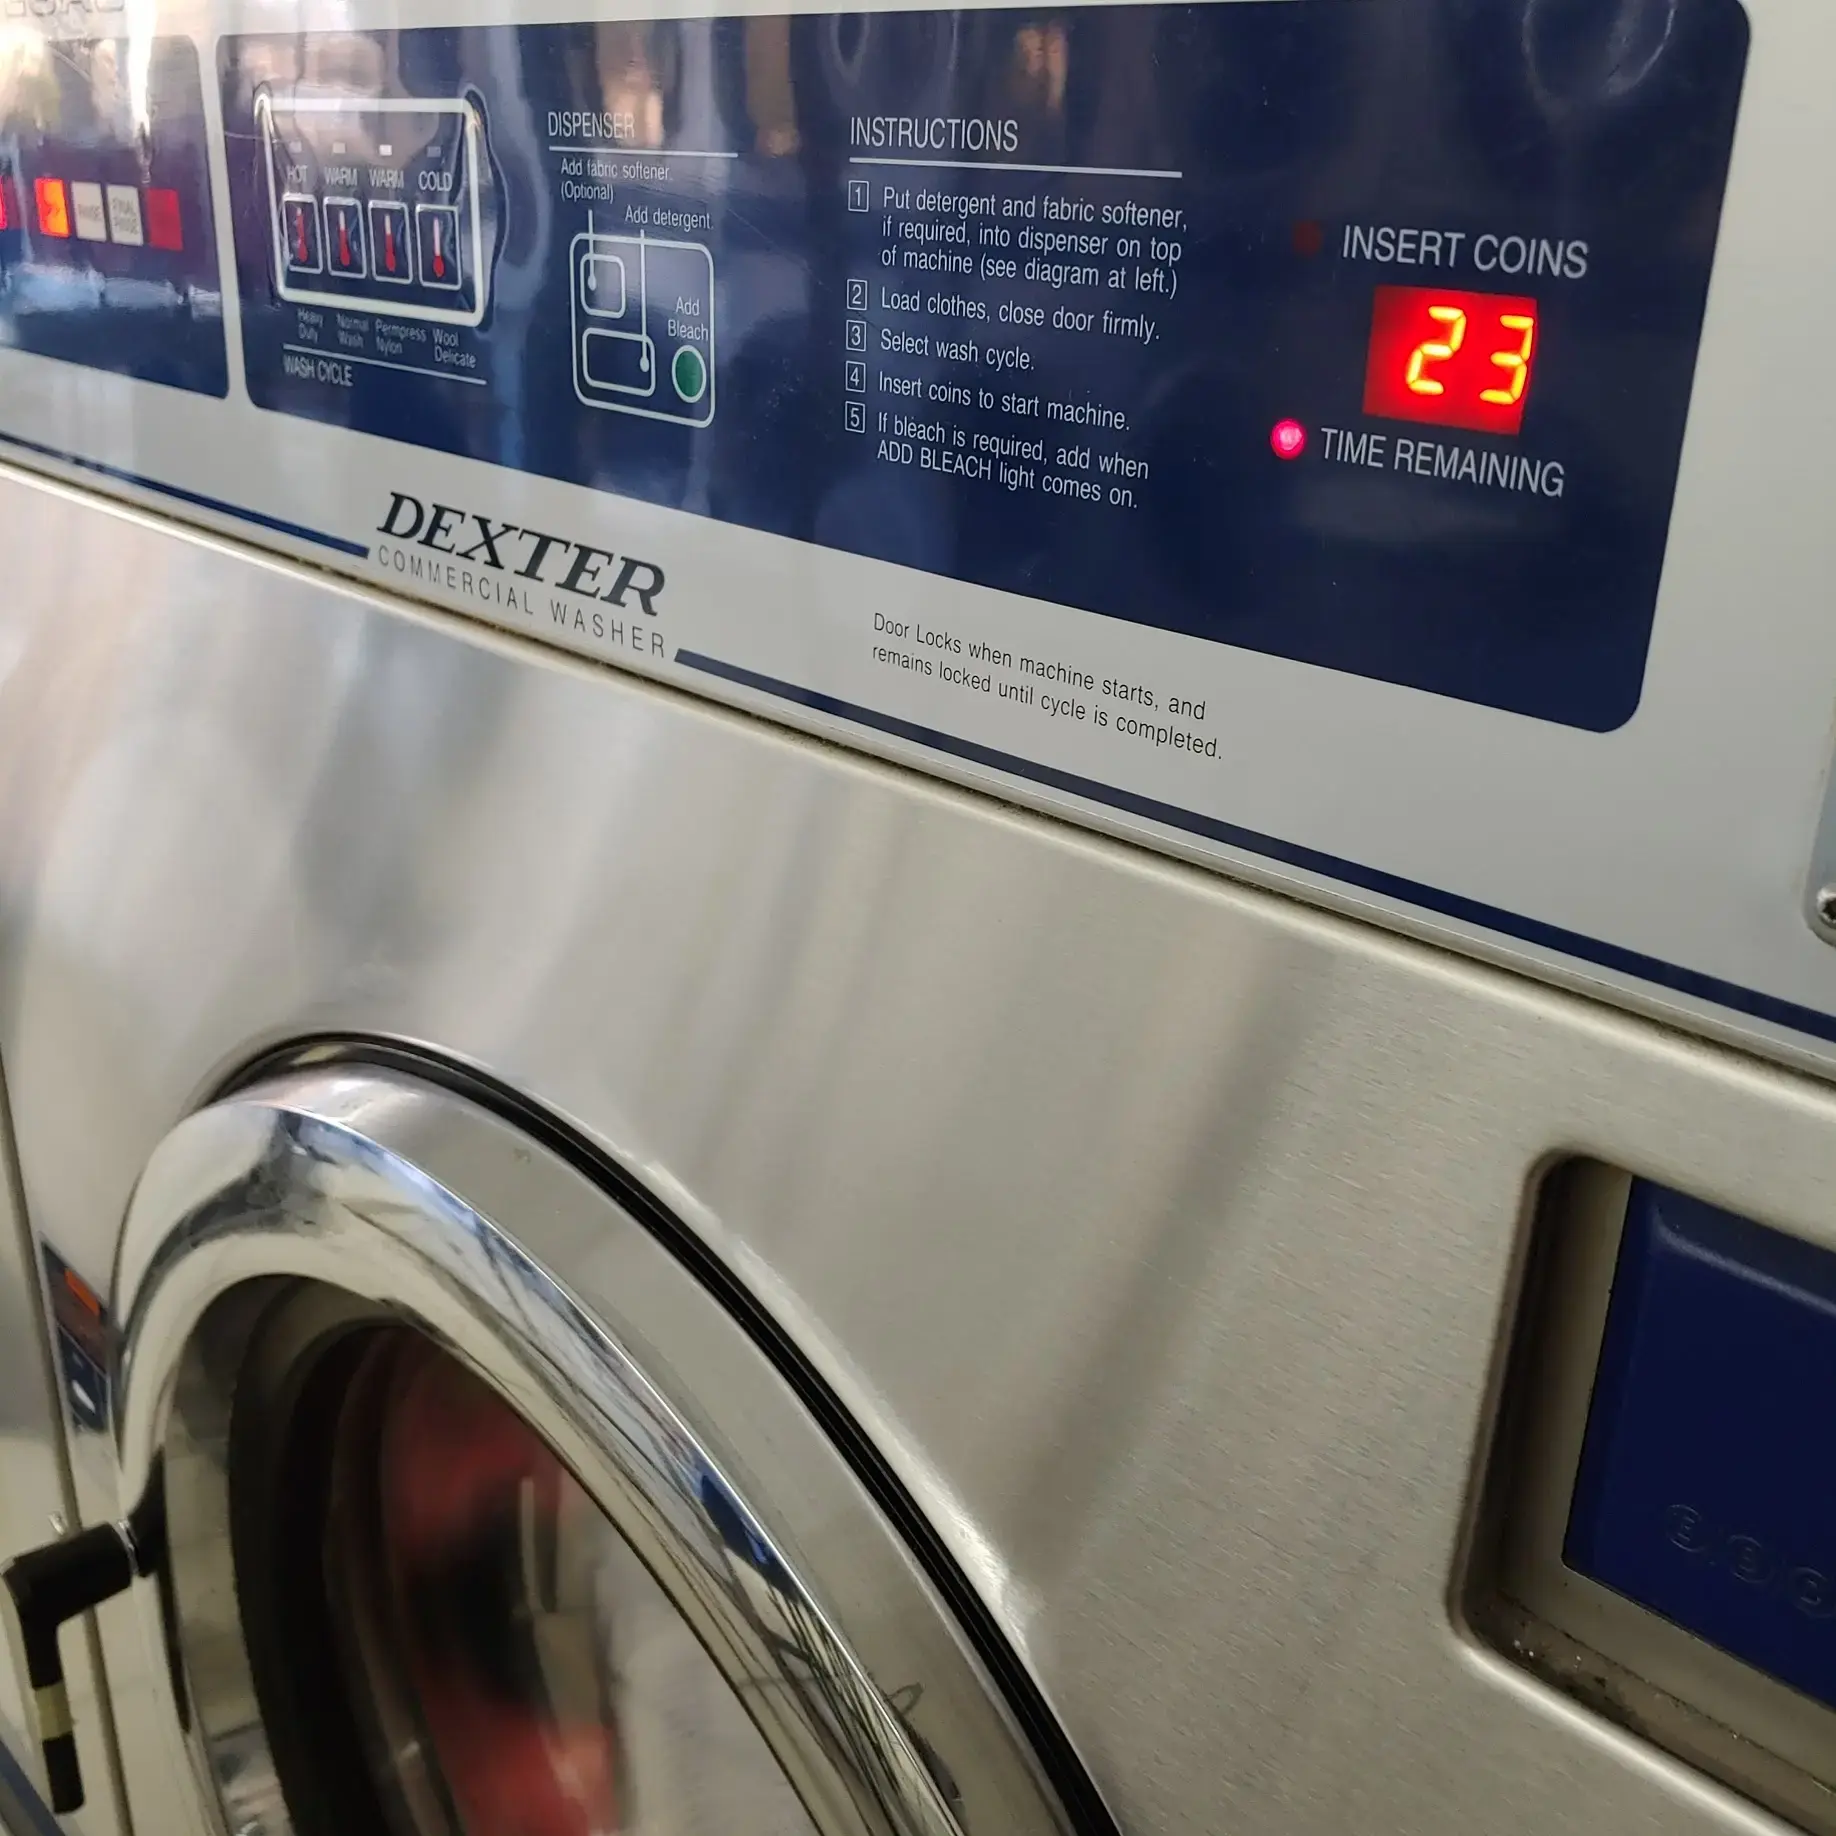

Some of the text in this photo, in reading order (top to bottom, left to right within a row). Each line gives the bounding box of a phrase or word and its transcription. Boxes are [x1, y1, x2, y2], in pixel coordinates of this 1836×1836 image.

[548, 111, 635, 139] DISPENSER
[850, 117, 1019, 151] INSTRUCTIONS
[287, 166, 308, 182] HOT
[324, 168, 358, 186] WARM
[369, 169, 404, 188] WARM
[418, 171, 452, 192] COLD
[561, 158, 673, 181] Add fabric softener.
[561, 180, 613, 203] (Optional)
[883, 186, 910, 210] Put
[916, 189, 996, 218] detergent
[1003, 196, 1035, 218] and
[1043, 196, 1094, 223] fabric
[1102, 200, 1187, 231] softener,
[625, 205, 714, 232] Add detergent.
[882, 215, 1182, 265] if required, into dispenser on top
[1343, 225, 1589, 279] INSERT COINS
[882, 245, 1177, 299] of machine (see diagram at left.)
[676, 297, 700, 316] Add
[882, 287, 920, 312] Load
[927, 292, 990, 323] clothes,
[999, 300, 1044, 327] close
[1053, 306, 1094, 331] door
[1103, 310, 1160, 345] firmly.
[375, 319, 428, 342] Permpress
[376, 336, 403, 356] Nylon
[432, 328, 459, 346] Wool
[668, 320, 709, 341] Bleach
[434, 345, 476, 368] Delicate
[880, 328, 929, 356] Select
[936, 338, 978, 362] wash
[986, 346, 1035, 371] cycle.
[1406, 306, 1534, 405] 23
[283, 355, 354, 387] WASH CYCLE
[879, 371, 922, 398] Insert
[929, 381, 971, 406] coins
[978, 388, 994, 409] to
[1001, 394, 1039, 417] start
[1047, 401, 1130, 431] machine.
[878, 412, 888, 432] If
[894, 415, 945, 443] bleach
[953, 425, 965, 447] is
[973, 432, 1048, 464] required,
[1056, 445, 1090, 469] add
[1099, 452, 1149, 480] when
[1321, 427, 1565, 498] TIME REMAINING
[878, 439, 1138, 508] ADD BLEACH light comes on.
[376, 491, 665, 617] DEXTER
[378, 545, 665, 658] COMMERCIAL WASHER
[874, 612, 1206, 721] Door Locks when machine starts, and
[872, 644, 1222, 760] remains locked until cycle is completed.
